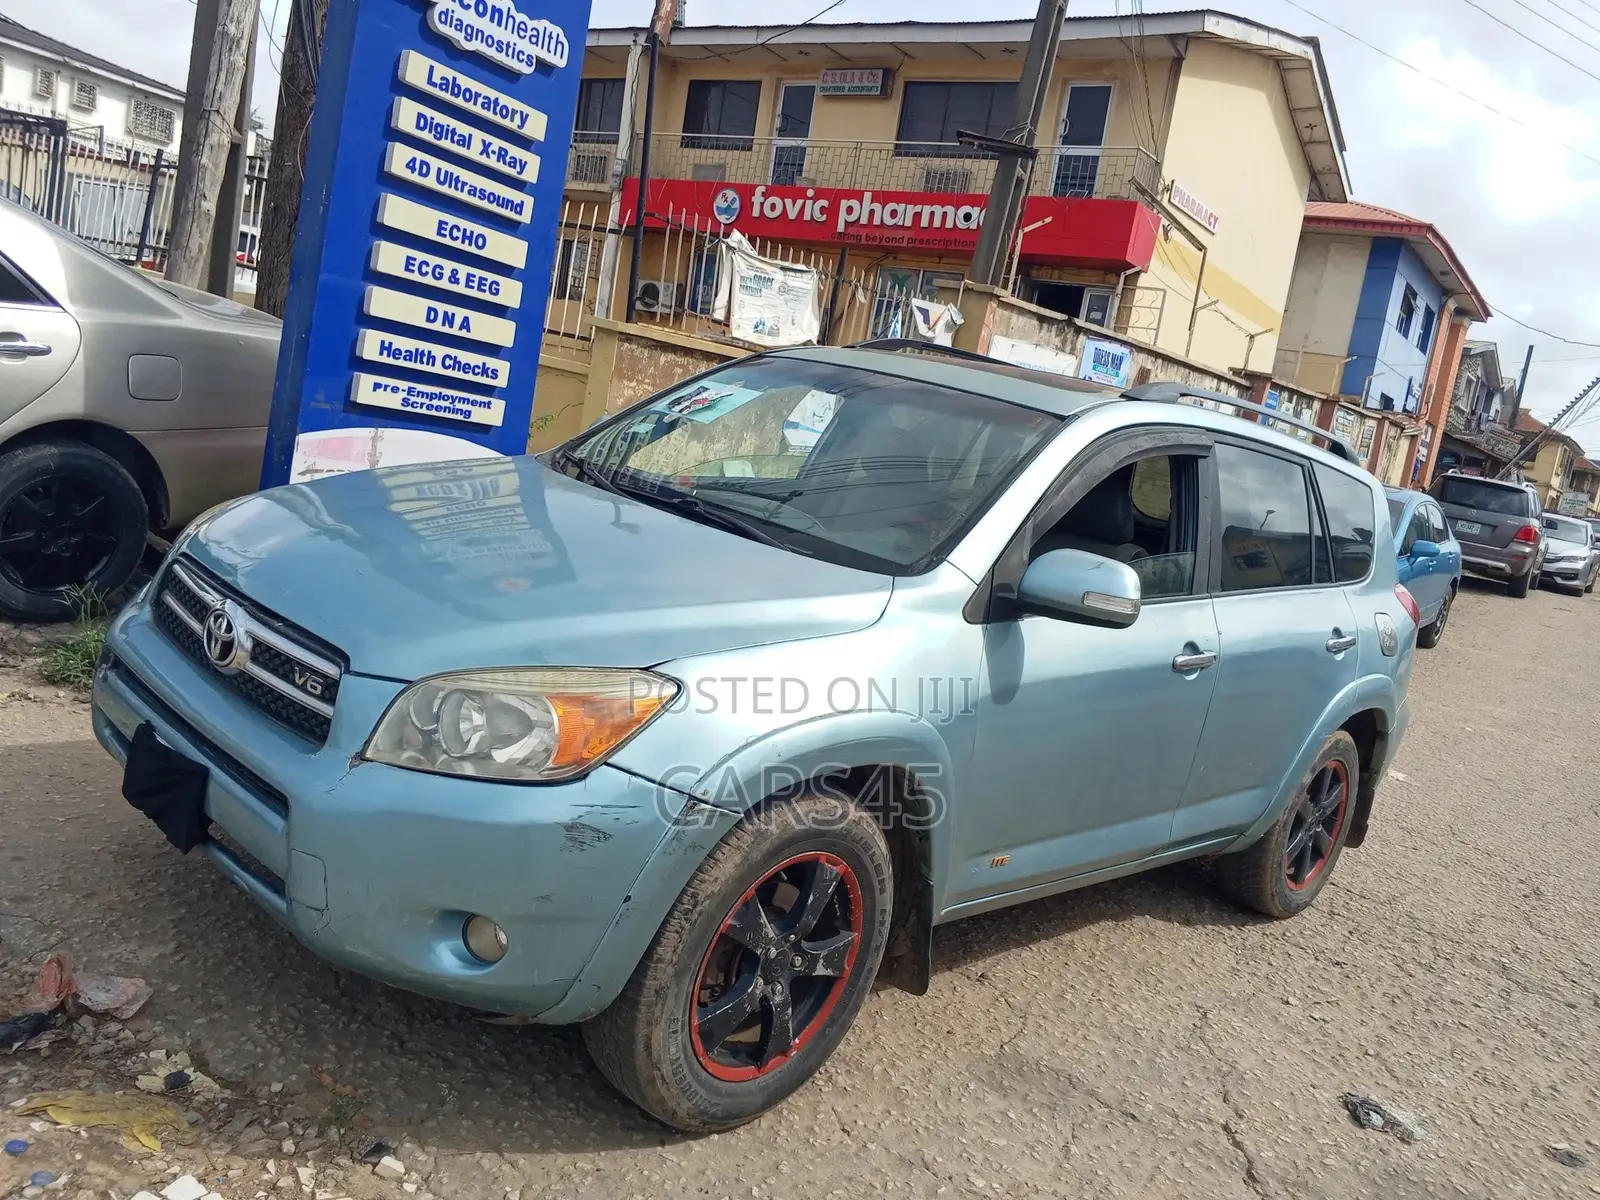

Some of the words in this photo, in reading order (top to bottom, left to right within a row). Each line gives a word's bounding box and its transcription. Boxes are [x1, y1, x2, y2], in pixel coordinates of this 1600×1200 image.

[438, 8, 535, 68] diagnostics
[426, 65, 530, 129] Laboratory
[415, 112, 473, 151] Digital
[479, 138, 529, 175] X-Ray
[405, 157, 431, 178] 4D
[436, 167, 525, 216] Ultrasound
[751, 186, 829, 221] fovic
[1172, 185, 1219, 230] PHARMACY
[436, 219, 487, 250] ECHO
[865, 233, 905, 245] beyond
[906, 236, 976, 248] prescription
[404, 255, 444, 281] ECG
[447, 268, 461, 286] &
[465, 272, 501, 297] EEG
[378, 339, 436, 367] Health
[441, 353, 499, 380] Checks
[1093, 347, 1111, 369] DRESS
[1111, 352, 1124, 371] MAN
[401, 397, 472, 419] Screening
[294, 666, 324, 696] V6
